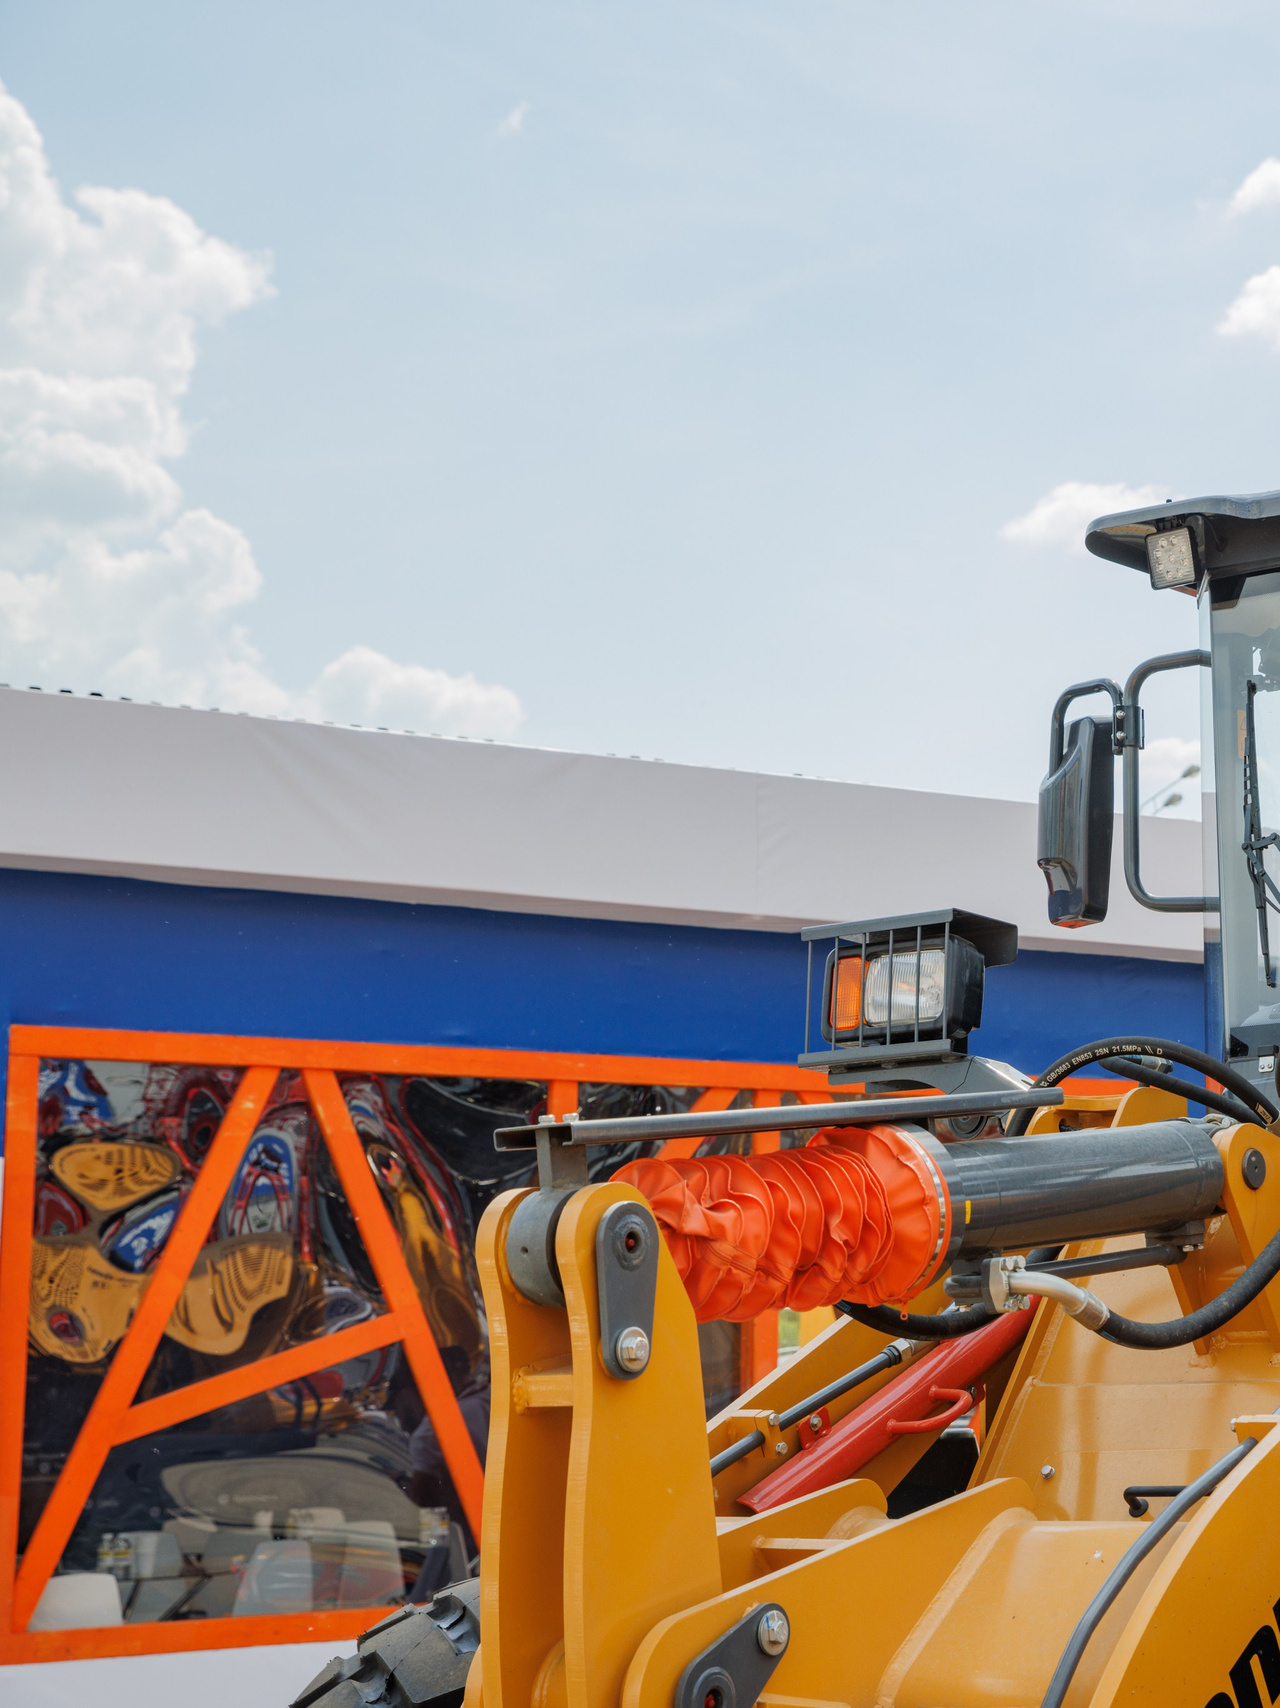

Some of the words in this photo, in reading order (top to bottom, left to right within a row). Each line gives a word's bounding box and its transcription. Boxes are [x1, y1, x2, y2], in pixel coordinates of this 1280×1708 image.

[1046, 1062, 1071, 1083] GB/3683
[1071, 1051, 1093, 1065] EN853
[1094, 1047, 1110, 1056] 2SN
[1111, 1044, 1142, 1053] 21.5MPa
